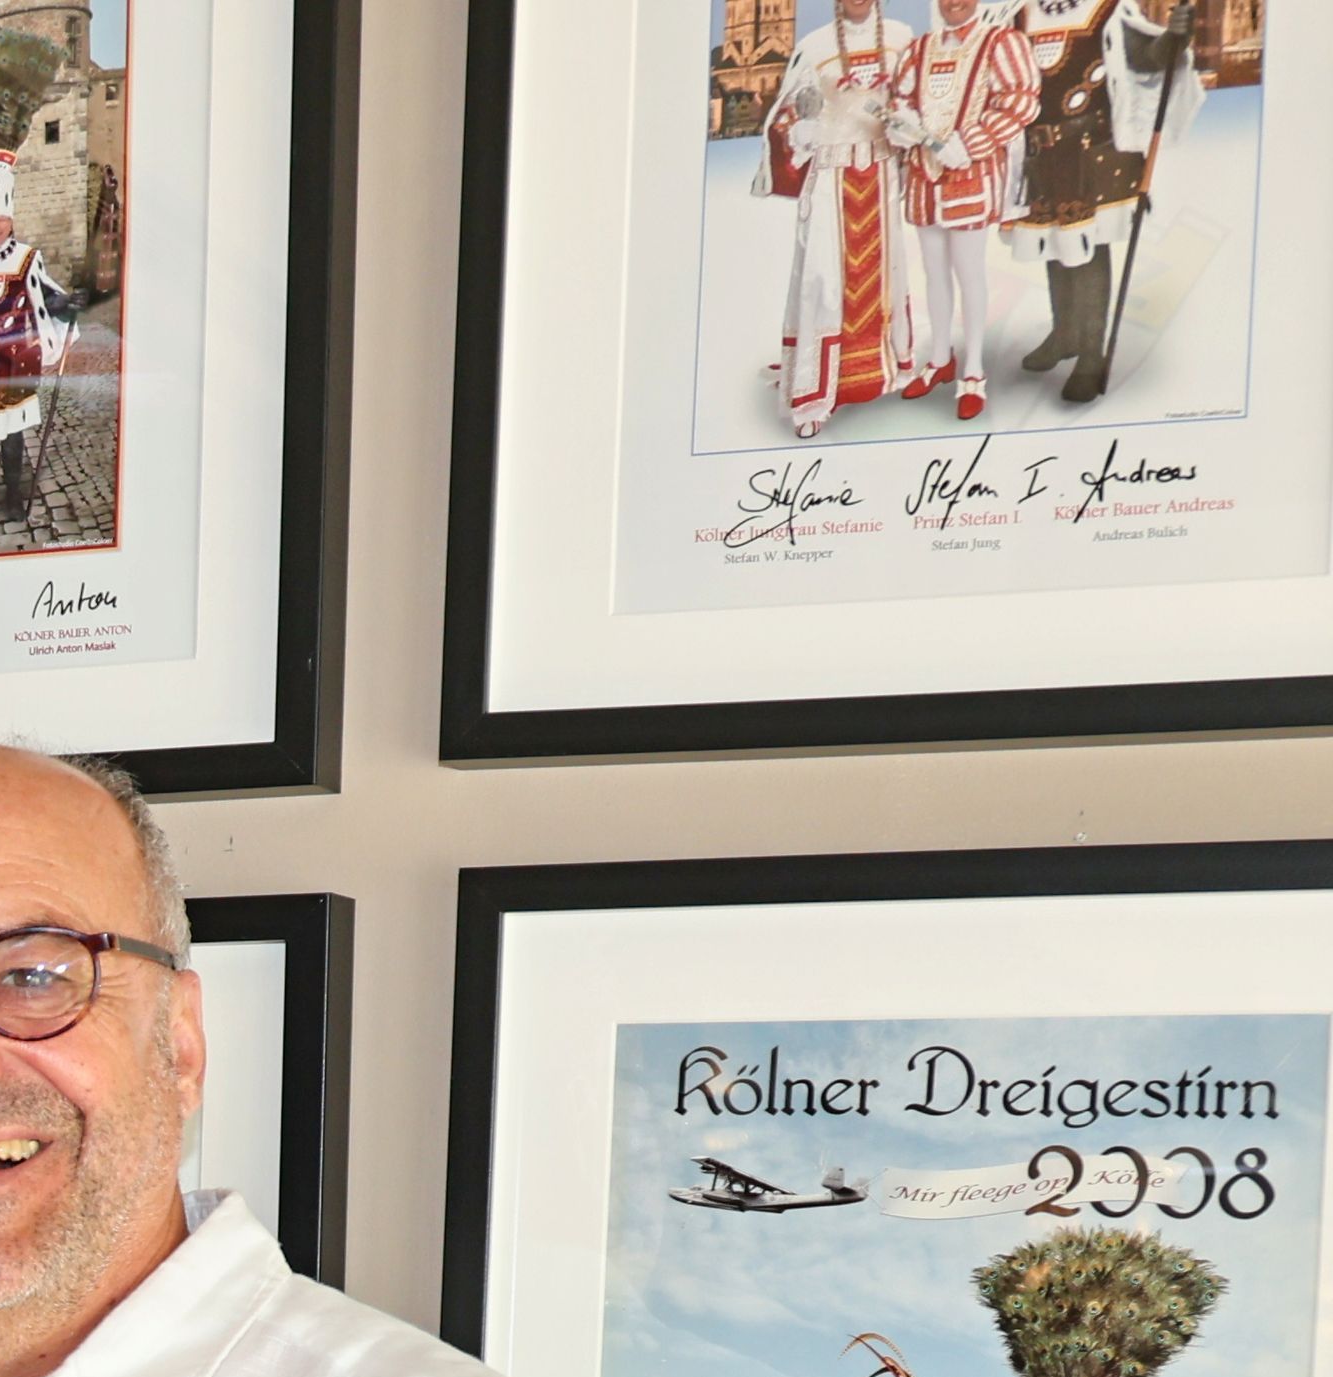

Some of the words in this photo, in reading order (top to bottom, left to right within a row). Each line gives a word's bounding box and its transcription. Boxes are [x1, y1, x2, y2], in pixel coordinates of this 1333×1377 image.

[1054, 505, 1108, 521] Kölner
[1113, 503, 1161, 517] Bauer
[1165, 498, 1235, 513] Andreas
[913, 514, 954, 530] Prinz
[958, 512, 1004, 527] Stefan
[694, 528, 744, 543] Kölner
[821, 520, 884, 535] Stefanie
[1093, 530, 1144, 543] Andreas
[1147, 526, 1188, 539] Bulich
[932, 539, 968, 551] Stefan
[971, 537, 1001, 550] Jung
[724, 553, 760, 565] Stefan
[784, 549, 833, 564] Knepper
[14, 630, 56, 642] KÖLNER
[94, 624, 132, 636] ANTON
[56, 644, 83, 654] Anton
[674, 1046, 880, 1117] Kölner
[905, 1046, 1279, 1128] Dreigestirn
[1025, 1144, 1276, 1220] 2008
[889, 1184, 939, 1203] Mir
[940, 1179, 1027, 1209] fleege
